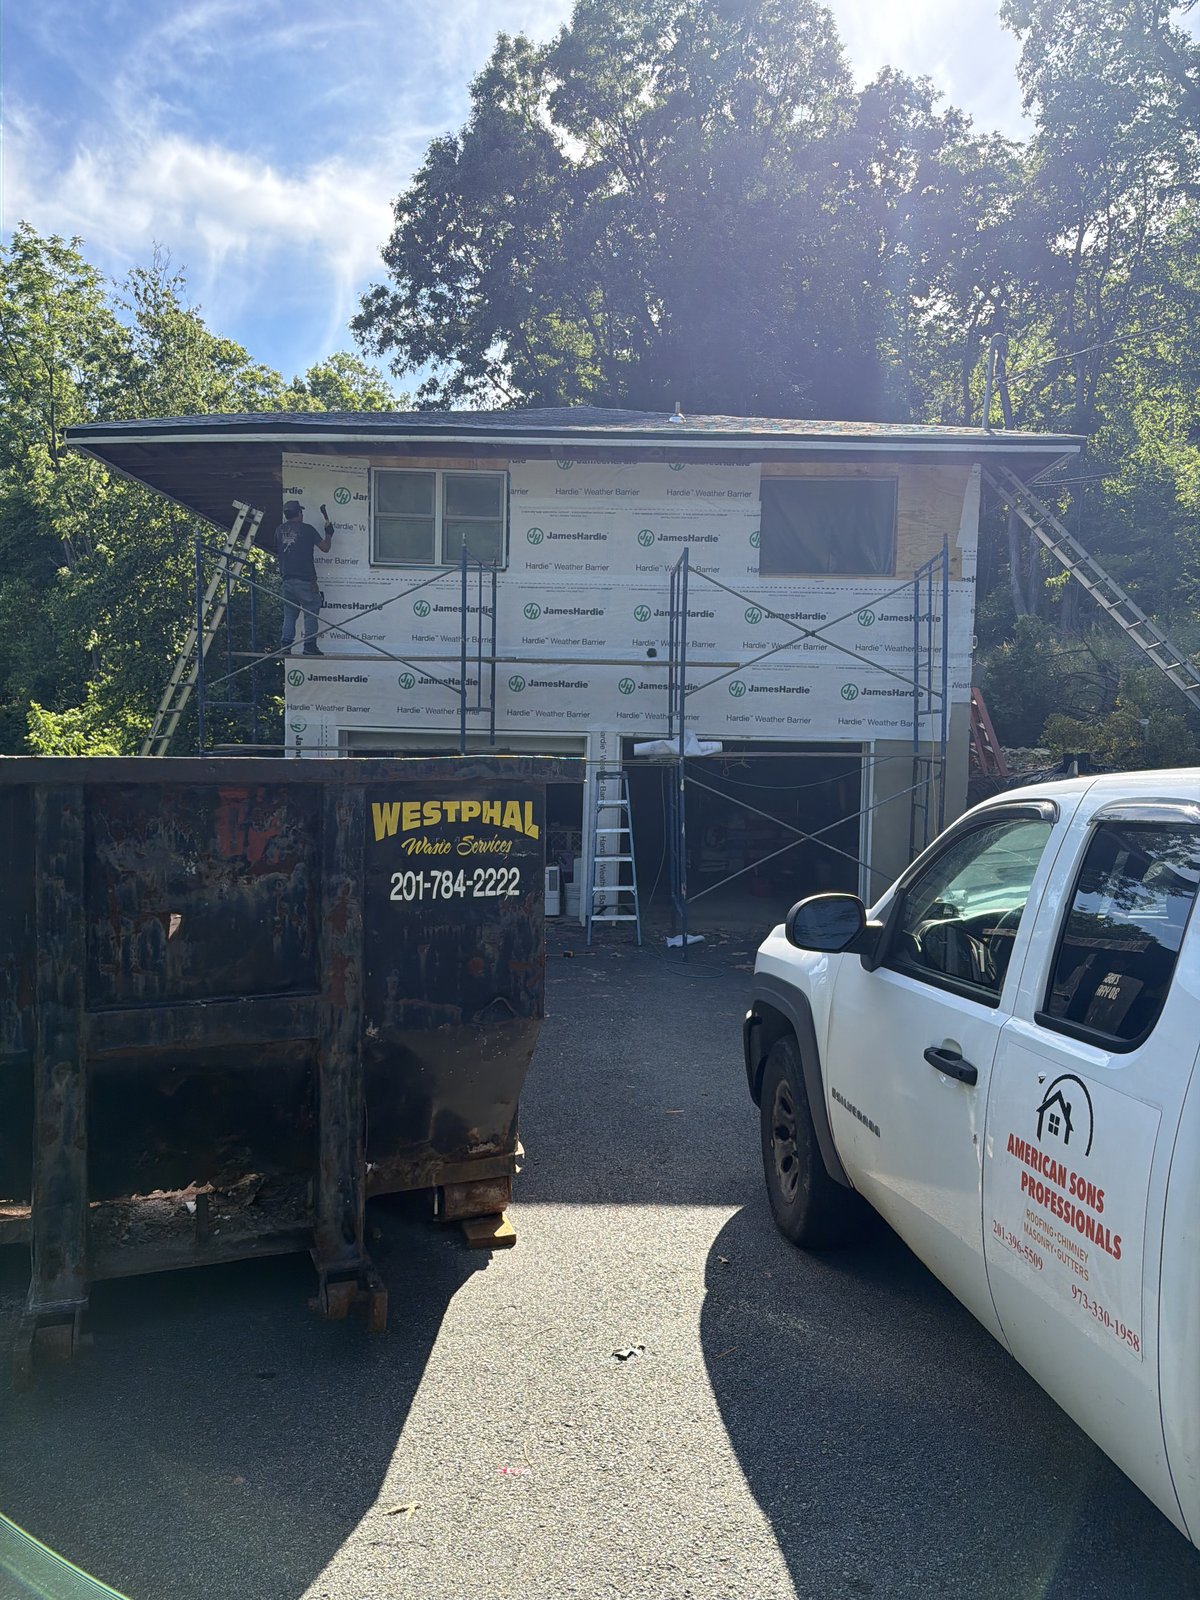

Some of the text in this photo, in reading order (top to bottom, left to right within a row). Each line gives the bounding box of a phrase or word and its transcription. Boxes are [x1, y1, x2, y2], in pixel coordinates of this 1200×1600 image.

[547, 532, 607, 541] JamesHardie
[658, 534, 718, 542] JamesHardie
[543, 607, 604, 616] JamesHardie
[308, 674, 368, 682] JamesHardie
[528, 680, 588, 688] JamesHardie
[748, 684, 810, 694] JamesHardie
[372, 800, 539, 842] WESTPHAL
[401, 834, 512, 856] Waste Services
[390, 867, 520, 900] 201-784-2222
[1006, 1133, 1104, 1214] AMERICAN SONS
[1020, 1171, 1122, 1260] PROFESSIONALS
[993, 1220, 1043, 1270] 201-396-5509
[1071, 1284, 1140, 1352] 973-330-1958
